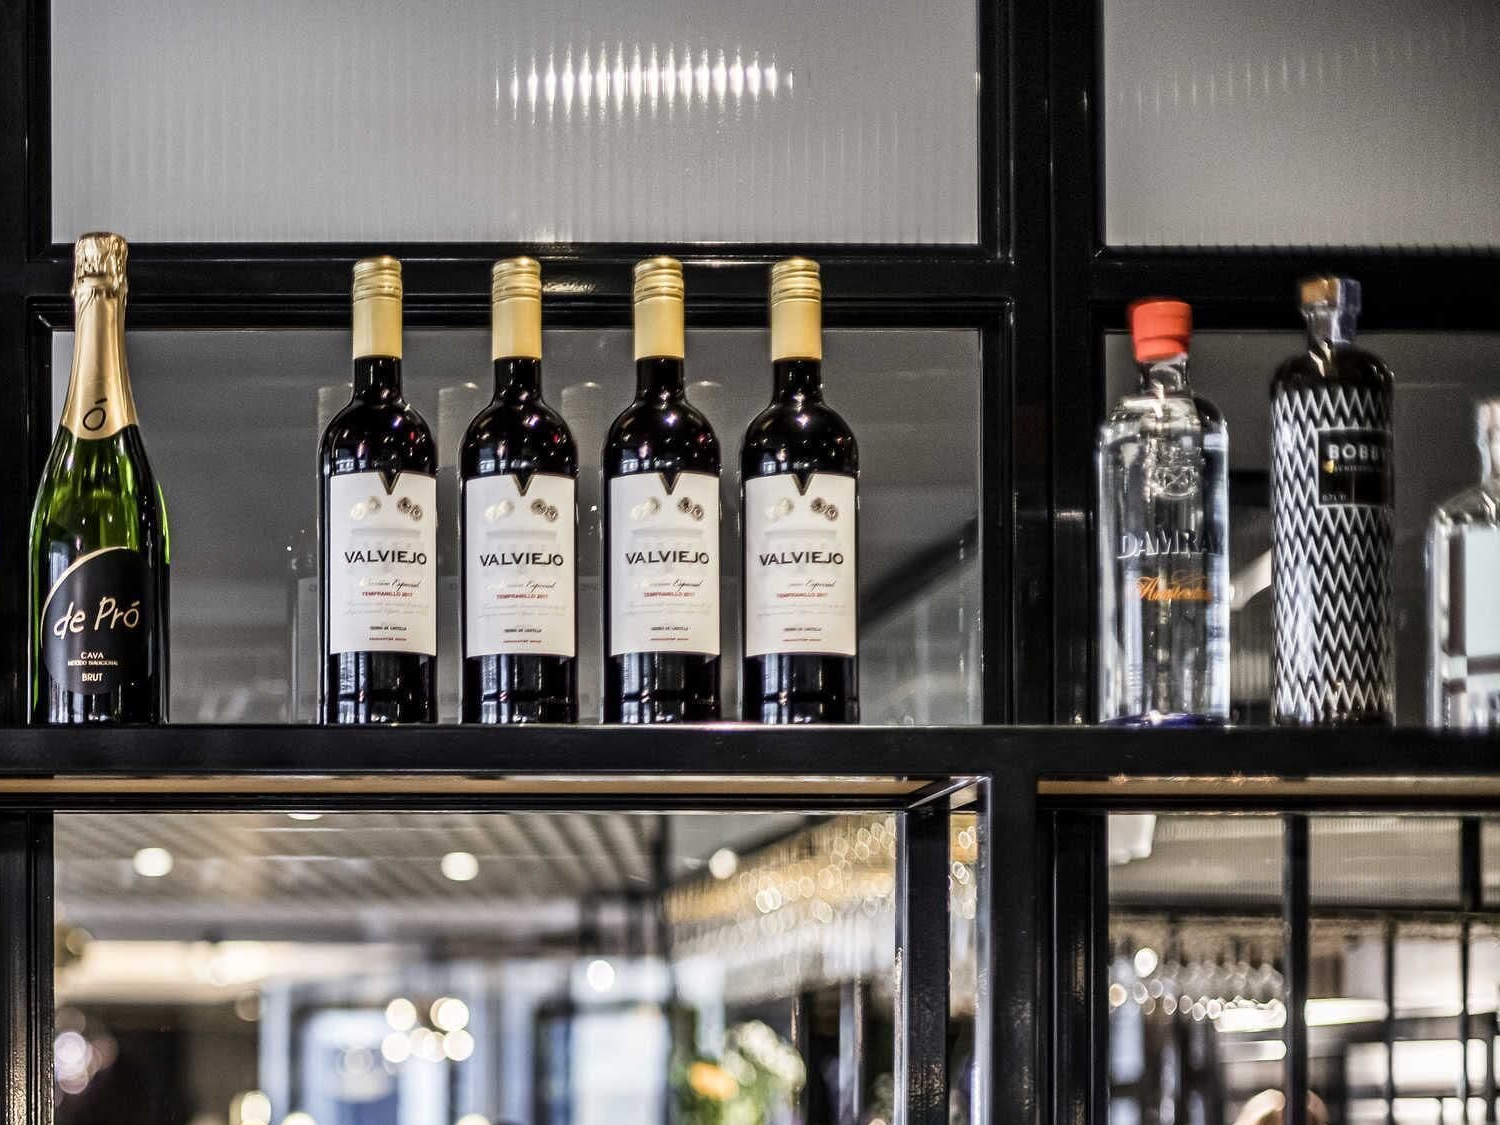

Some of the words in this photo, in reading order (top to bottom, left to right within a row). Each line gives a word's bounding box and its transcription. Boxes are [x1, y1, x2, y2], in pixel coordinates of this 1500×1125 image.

[344, 550, 428, 565] VALVIEJO
[480, 552, 564, 567] VALVIEJO
[626, 550, 710, 565] VALVIEJO
[760, 551, 844, 566] VALVIEJO
[53, 601, 86, 640] de
[94, 596, 140, 630] Pró
[80, 651, 104, 660] CAVA
[82, 672, 103, 682] BRUT
